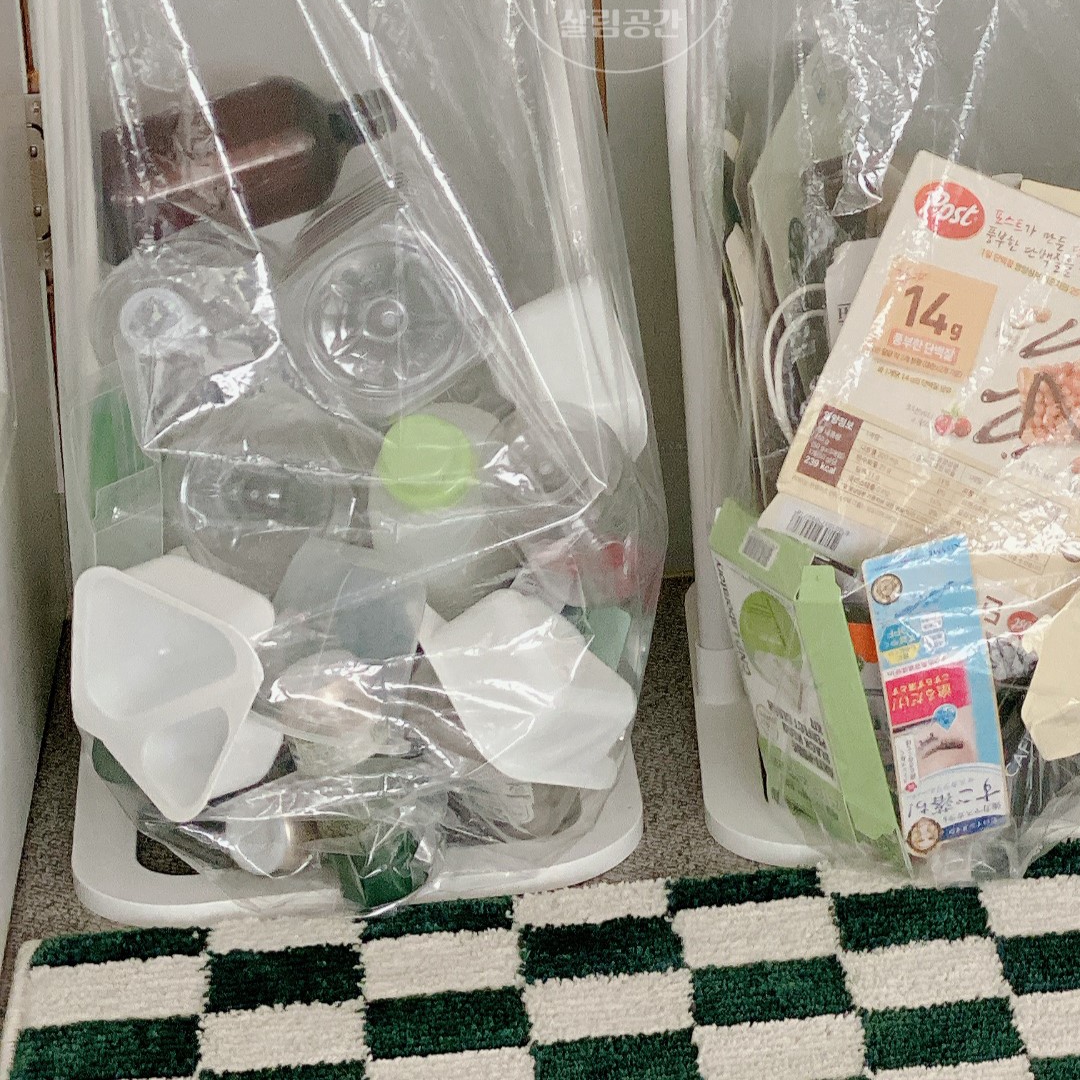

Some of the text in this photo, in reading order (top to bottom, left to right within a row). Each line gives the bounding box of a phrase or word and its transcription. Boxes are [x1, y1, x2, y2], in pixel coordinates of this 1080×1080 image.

[918, 185, 980, 227] Post
[994, 209, 1037, 236] 포스트가
[985, 225, 1019, 252] 풍부한
[803, 455, 838, 475] 239 kcal
[892, 682, 952, 712] 塗るだけ!
[1004, 735, 1032, 777] CAF
[908, 778, 1001, 818] すご落ち!
